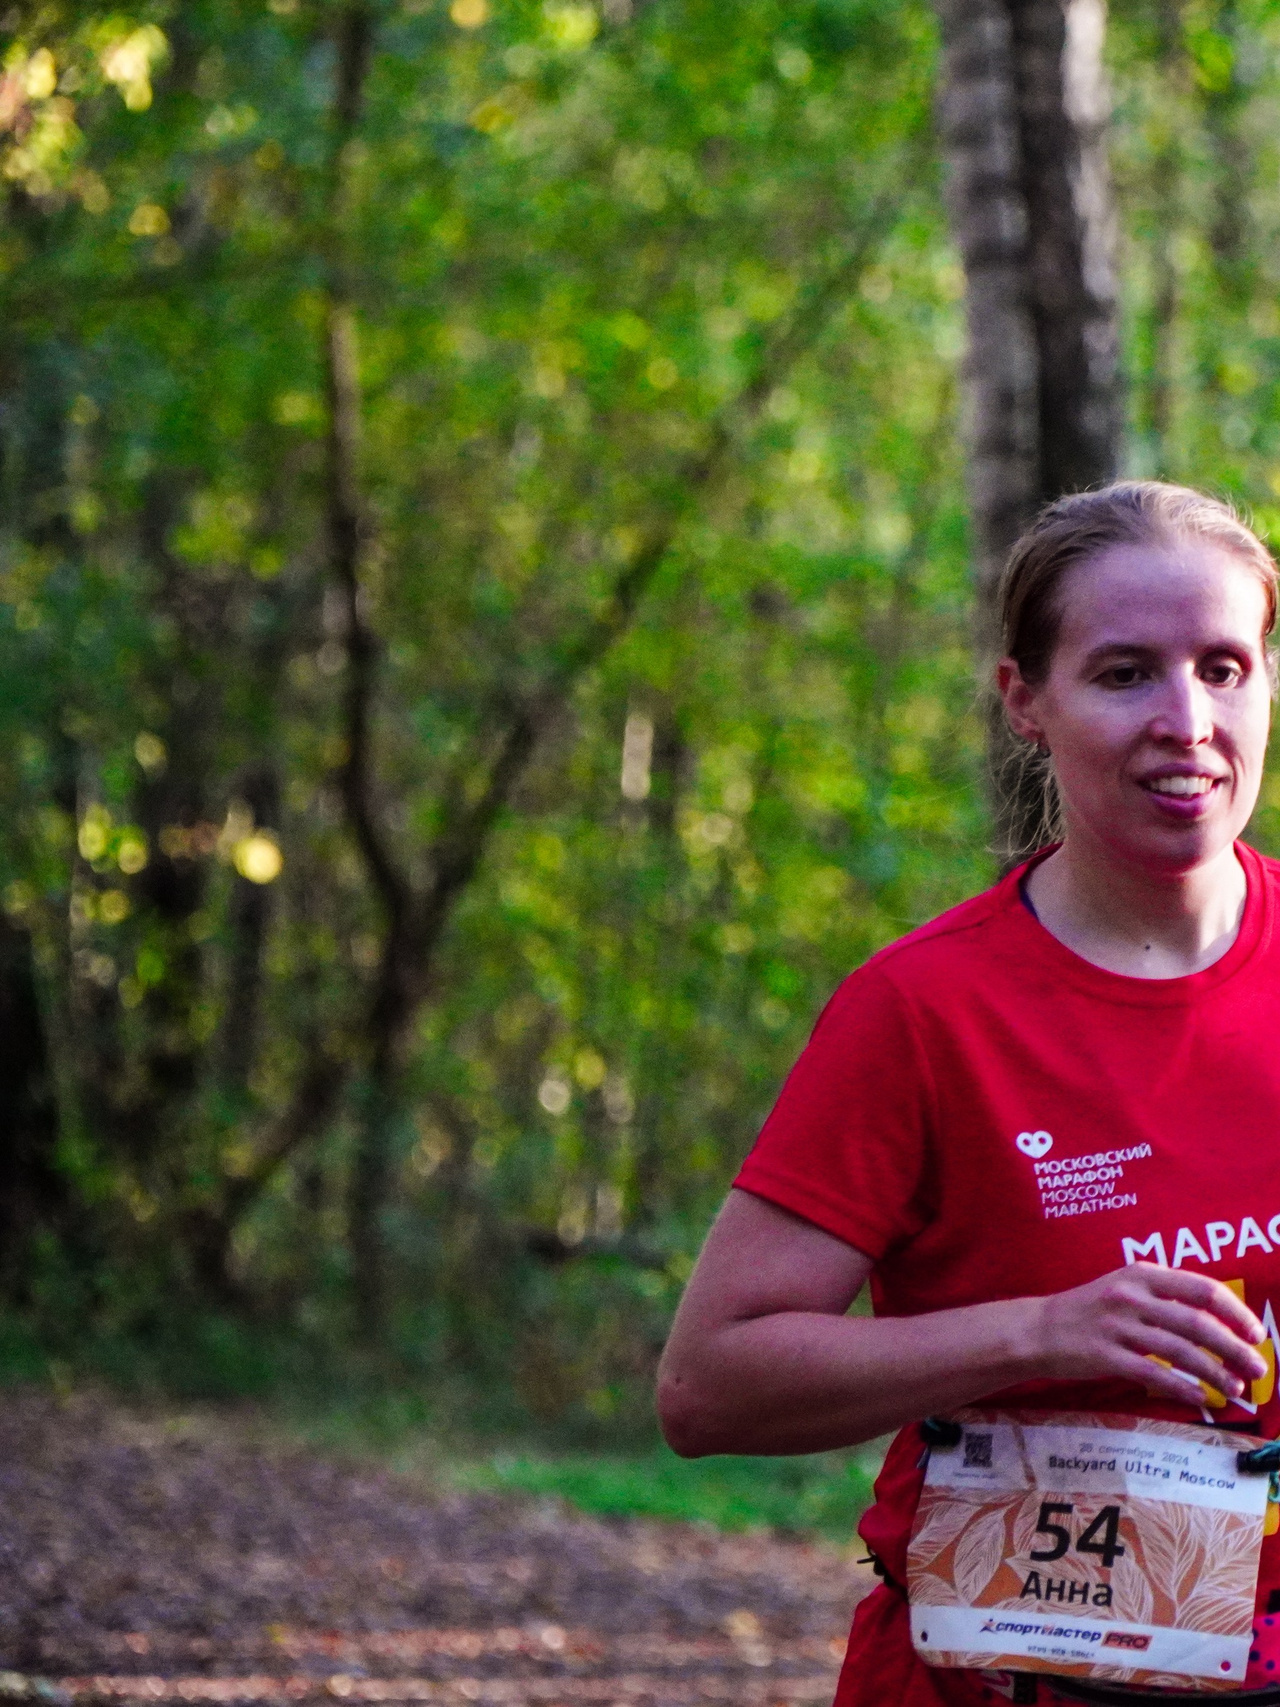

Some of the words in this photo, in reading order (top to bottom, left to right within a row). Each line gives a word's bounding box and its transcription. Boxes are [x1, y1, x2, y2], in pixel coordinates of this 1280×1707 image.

[1033, 1142, 1153, 1176] МОСКОВСКИЙ
[1037, 1164, 1124, 1190] МАРАФОН
[1041, 1181, 1115, 1204] MOSCOW
[1044, 1192, 1138, 1219] MARATHON
[1049, 1455, 1117, 1473] Backyard
[1125, 1459, 1171, 1480] Ultra
[1179, 1470, 1236, 1490] Moscow
[1030, 1502, 1125, 1568] 54
[1019, 1570, 1114, 1607] Анна
[1102, 1631, 1150, 1650] PRO
